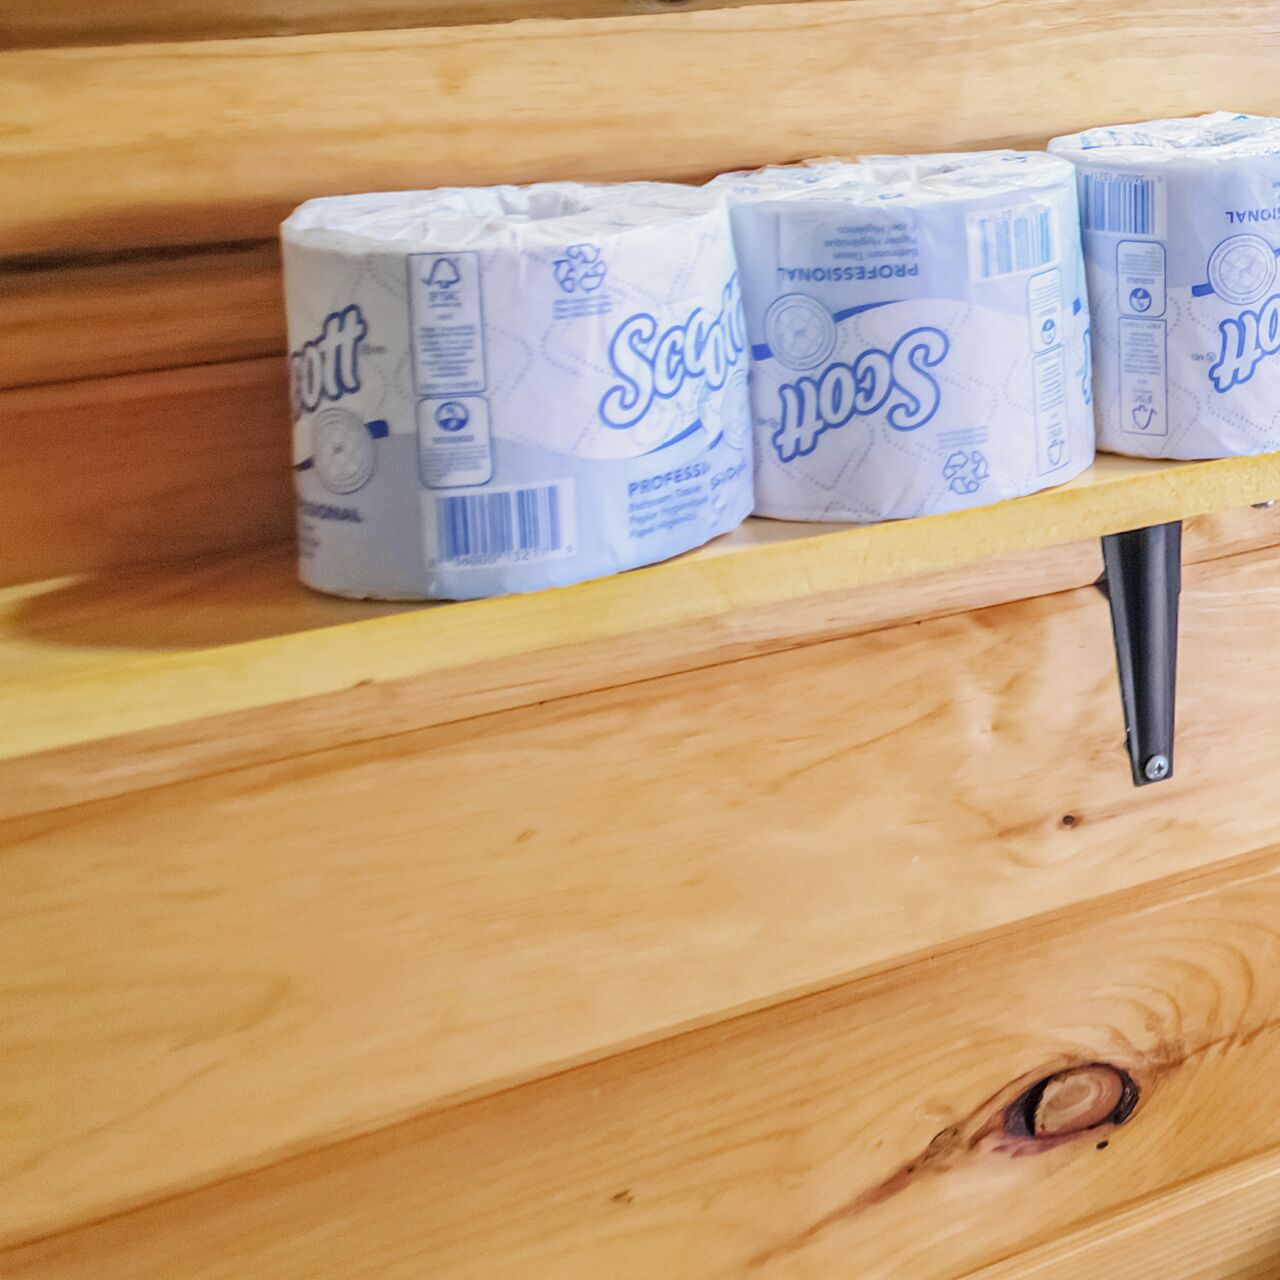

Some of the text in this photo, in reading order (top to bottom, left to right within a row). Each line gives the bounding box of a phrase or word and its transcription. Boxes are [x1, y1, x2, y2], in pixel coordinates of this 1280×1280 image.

[776, 263, 919, 283] PROFESSIONAL
[291, 303, 368, 423] ott
[771, 326, 950, 465] Scott
